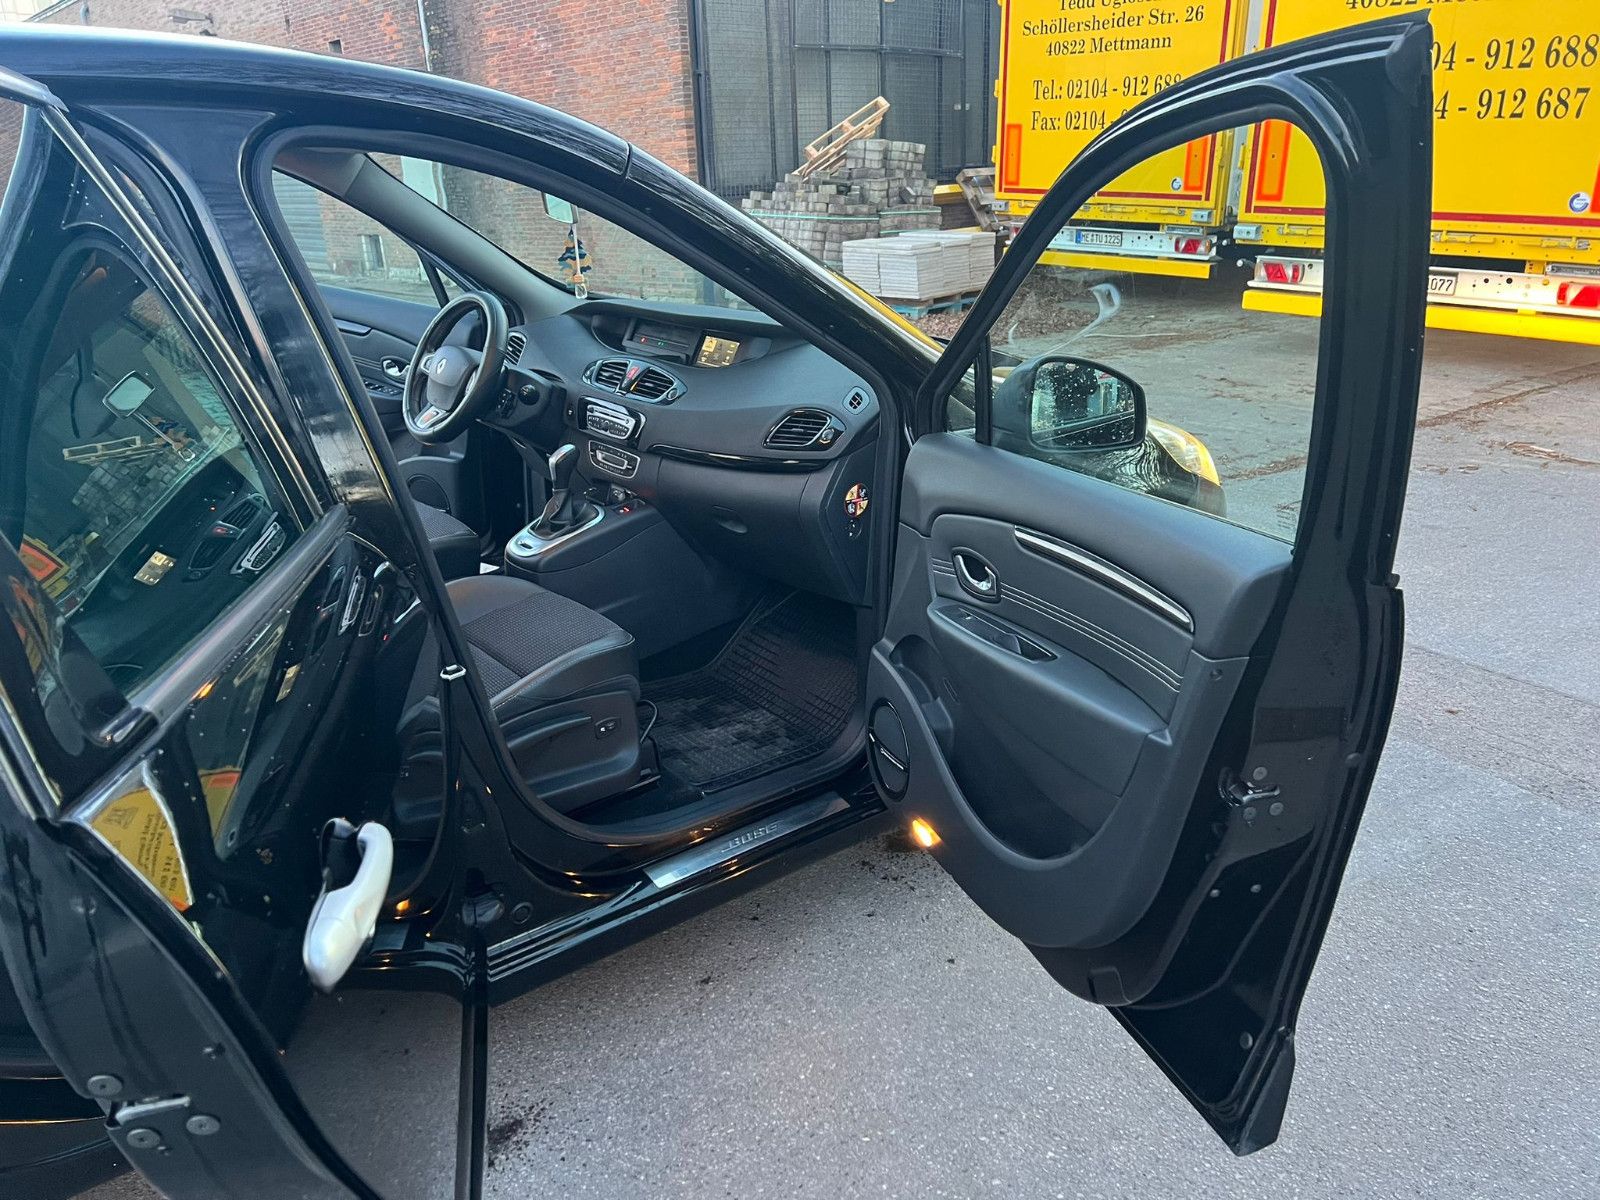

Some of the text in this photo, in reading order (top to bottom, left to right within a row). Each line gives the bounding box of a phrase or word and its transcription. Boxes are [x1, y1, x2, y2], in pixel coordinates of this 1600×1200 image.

[1022, 5, 1205, 36] Schöllersheider Str. 26
[1046, 35, 1172, 56] 40822 Mettmann
[1484, 37, 1535, 71] 912
[1544, 33, 1600, 68] 688
[1032, 79, 1062, 100] Tel.:
[1066, 77, 1108, 99] 02104
[1122, 75, 1149, 97] 912
[1476, 87, 1527, 120] 912
[1536, 87, 1591, 120] 687
[1032, 110, 1061, 131] Fax:
[1065, 109, 1105, 130] 02104
[1095, 233, 1104, 243] TU
[1104, 234, 1120, 245] 1225
